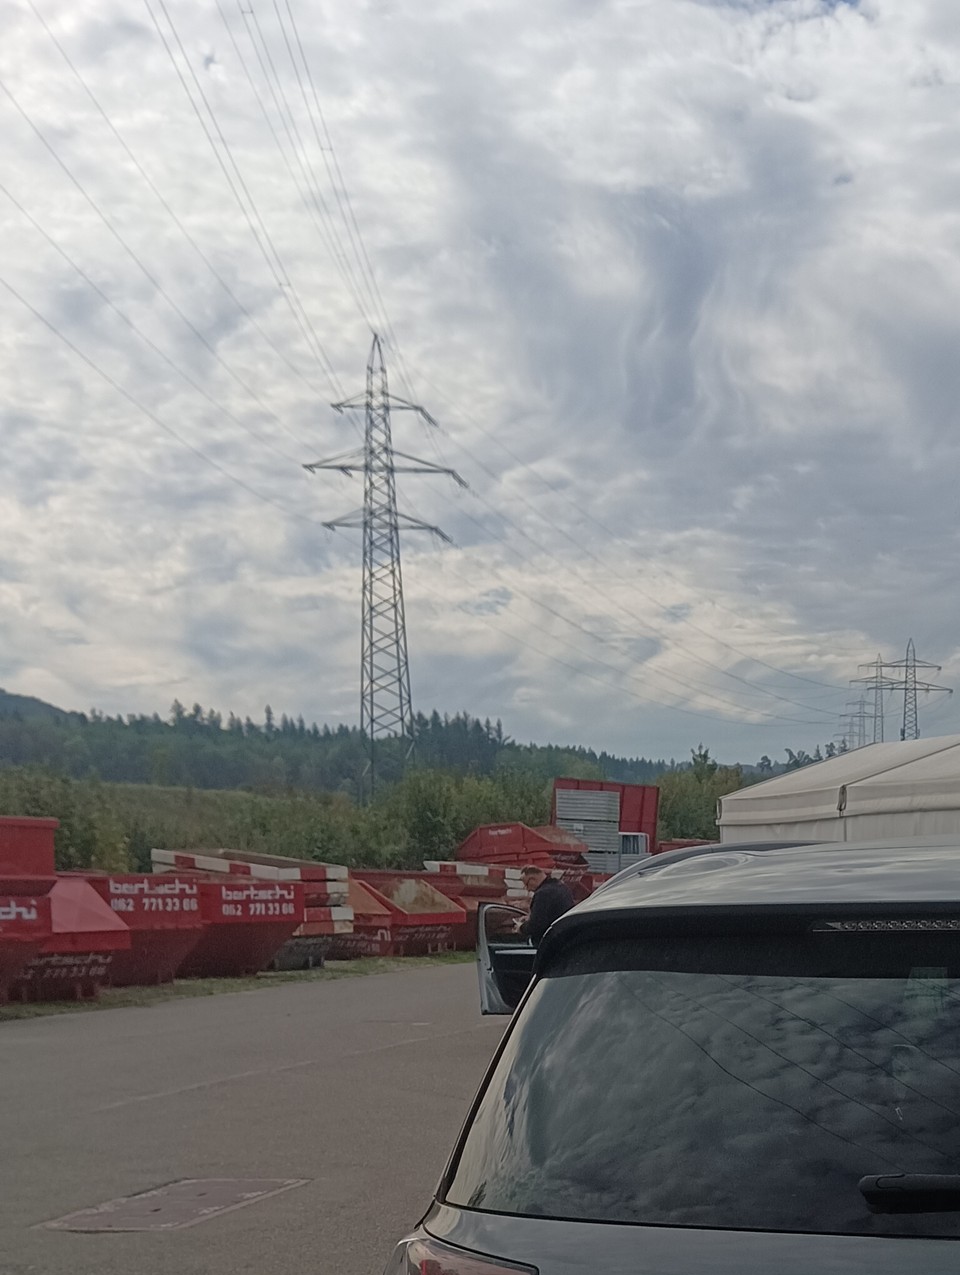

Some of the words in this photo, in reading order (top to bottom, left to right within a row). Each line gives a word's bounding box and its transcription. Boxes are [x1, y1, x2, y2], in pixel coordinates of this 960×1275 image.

[142, 898, 163, 912] 771
[165, 898, 180, 912] 33
[249, 903, 266, 916] 771
[267, 902, 280, 915] 33
